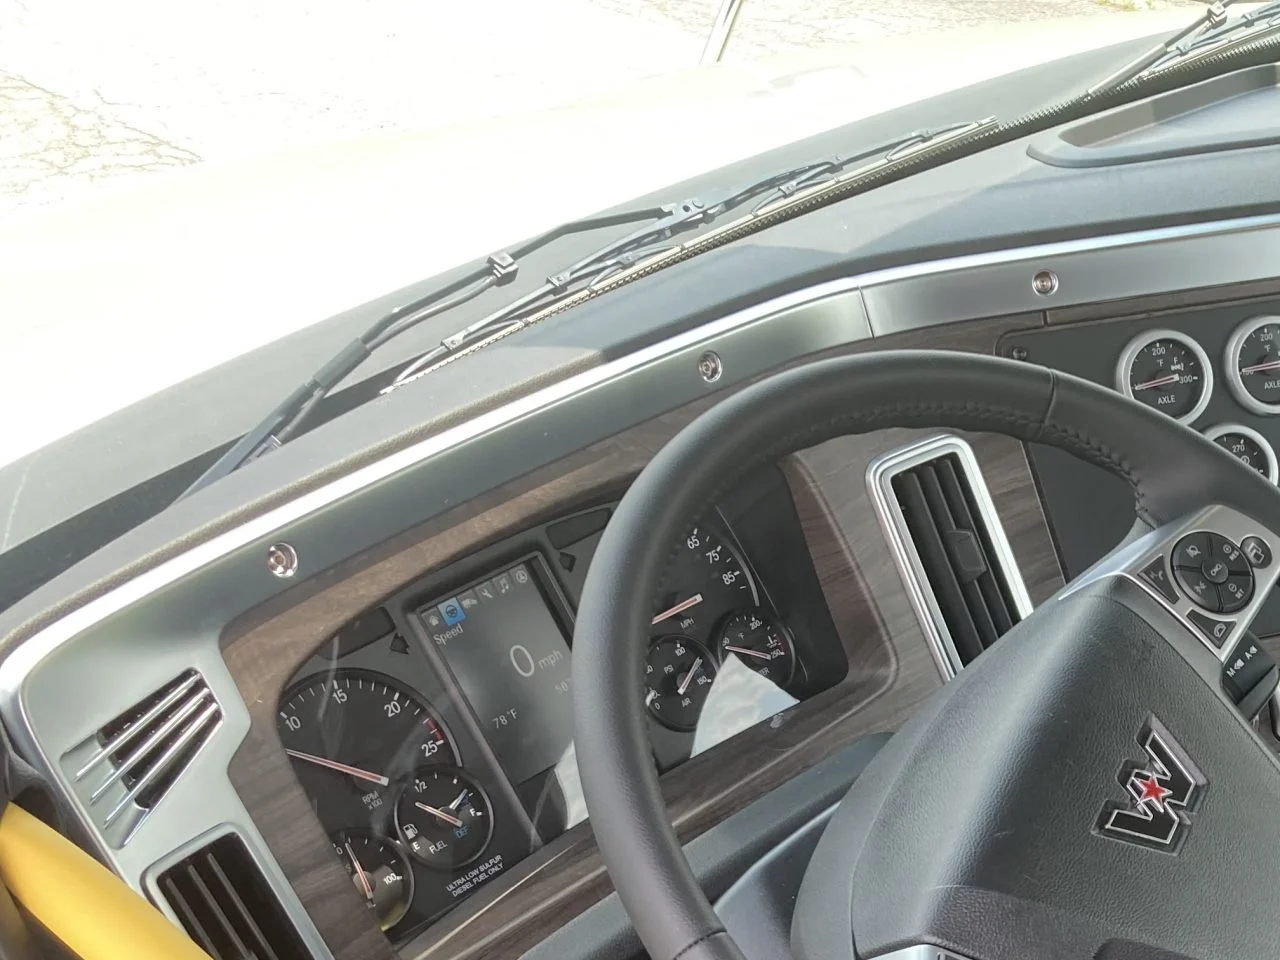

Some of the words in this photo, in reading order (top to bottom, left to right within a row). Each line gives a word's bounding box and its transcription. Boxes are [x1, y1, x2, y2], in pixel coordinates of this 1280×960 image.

[1260, 332, 1273, 342] 200
[1151, 347, 1166, 357] 200
[1173, 356, 1179, 364] F
[1179, 374, 1194, 384] 300
[1157, 395, 1176, 405] AXLE
[1231, 443, 1246, 453] 270
[686, 535, 700, 549] 65
[705, 549, 720, 564] 75
[722, 570, 736, 585] 85
[680, 617, 695, 630] MPH
[433, 623, 464, 646] Speed
[510, 644, 535, 677] 0
[537, 649, 563, 670] mph
[1244, 651, 1253, 660] A
[1226, 667, 1236, 678] M
[333, 689, 348, 704] 15
[383, 701, 401, 718] 20
[285, 716, 301, 731] 10
[421, 740, 438, 757] 25
[414, 780, 428, 793] 1/2
[362, 790, 379, 805] RPM
[469, 808, 477, 817] F
[455, 826, 469, 839] DEF
[412, 840, 421, 850] E
[429, 839, 448, 855] FUEL
[383, 872, 397, 885] 100
[446, 876, 466, 891] ULTRA
[464, 867, 480, 880] LOW
[451, 881, 474, 897] DIESEL
[472, 872, 489, 884] FUEL
[487, 862, 503, 875] ONLY
